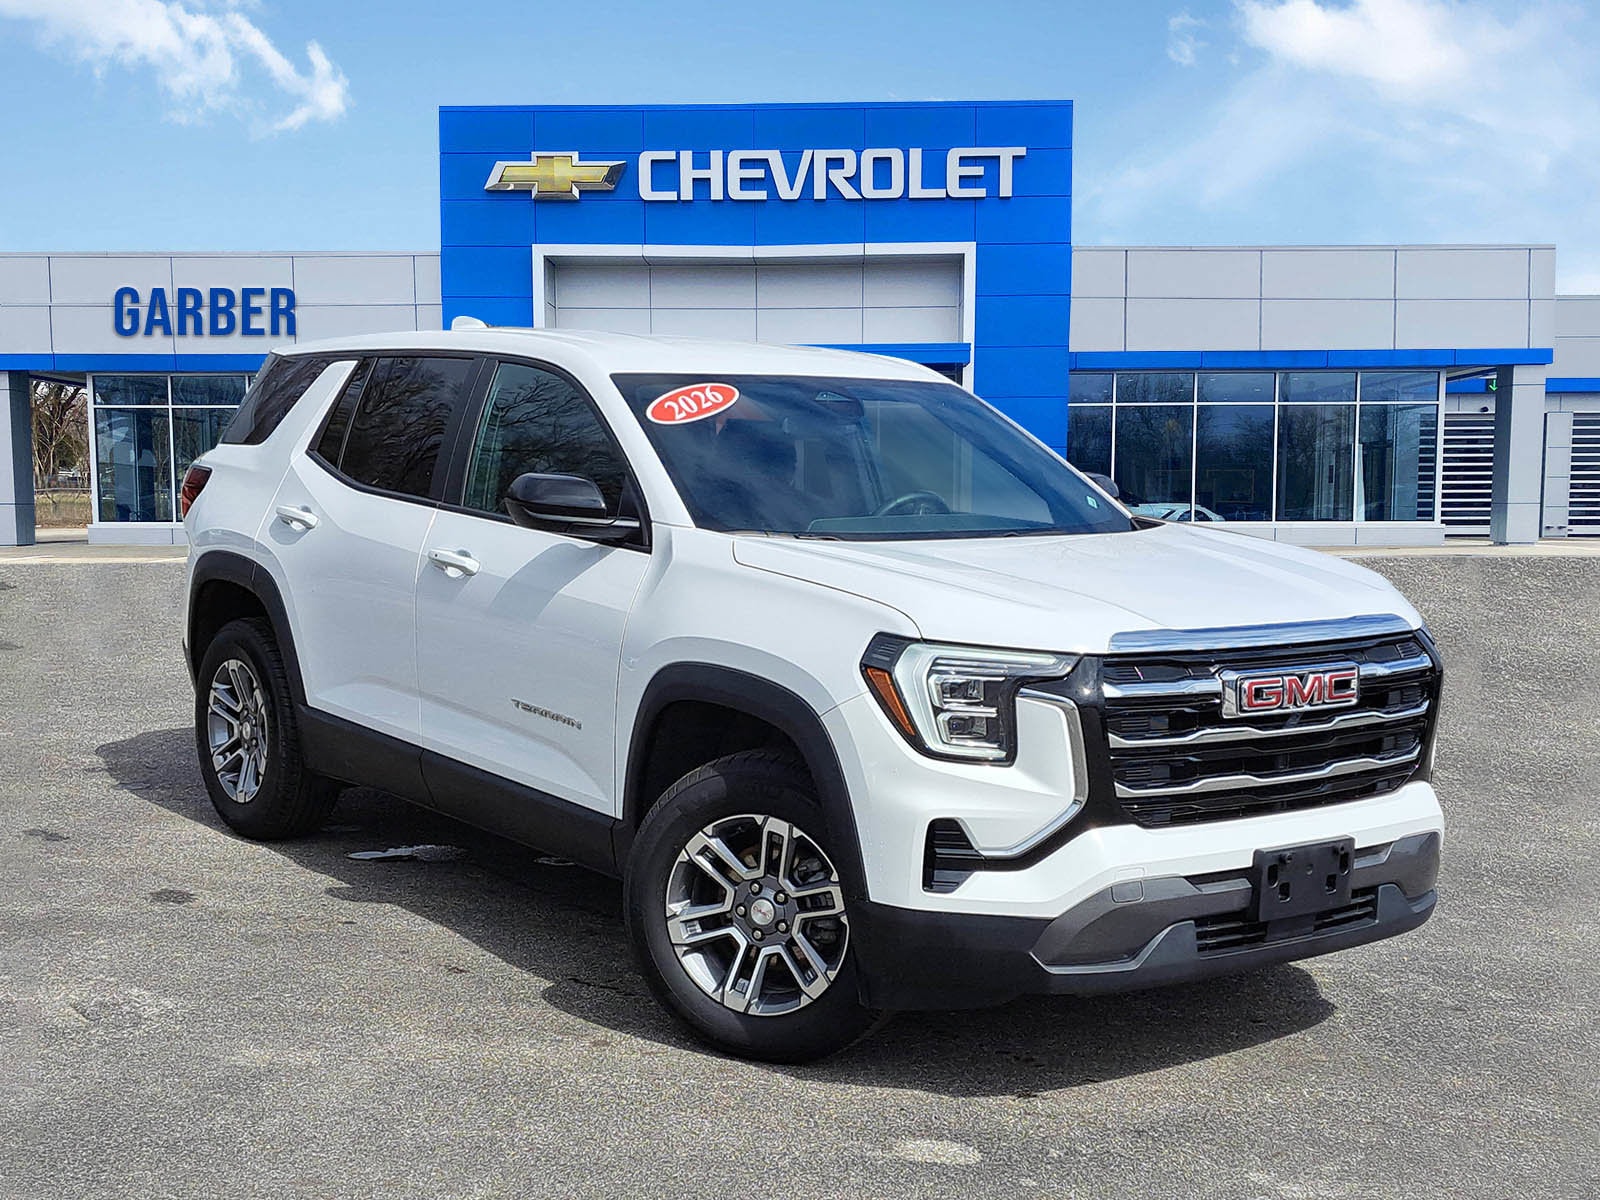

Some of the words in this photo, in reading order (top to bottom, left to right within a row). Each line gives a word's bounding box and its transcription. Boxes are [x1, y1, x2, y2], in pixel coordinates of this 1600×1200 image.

[638, 147, 1027, 201] CHEVROLET
[114, 286, 296, 337] GARBER
[664, 385, 724, 420] 2026
[1244, 671, 1357, 709] GMC
